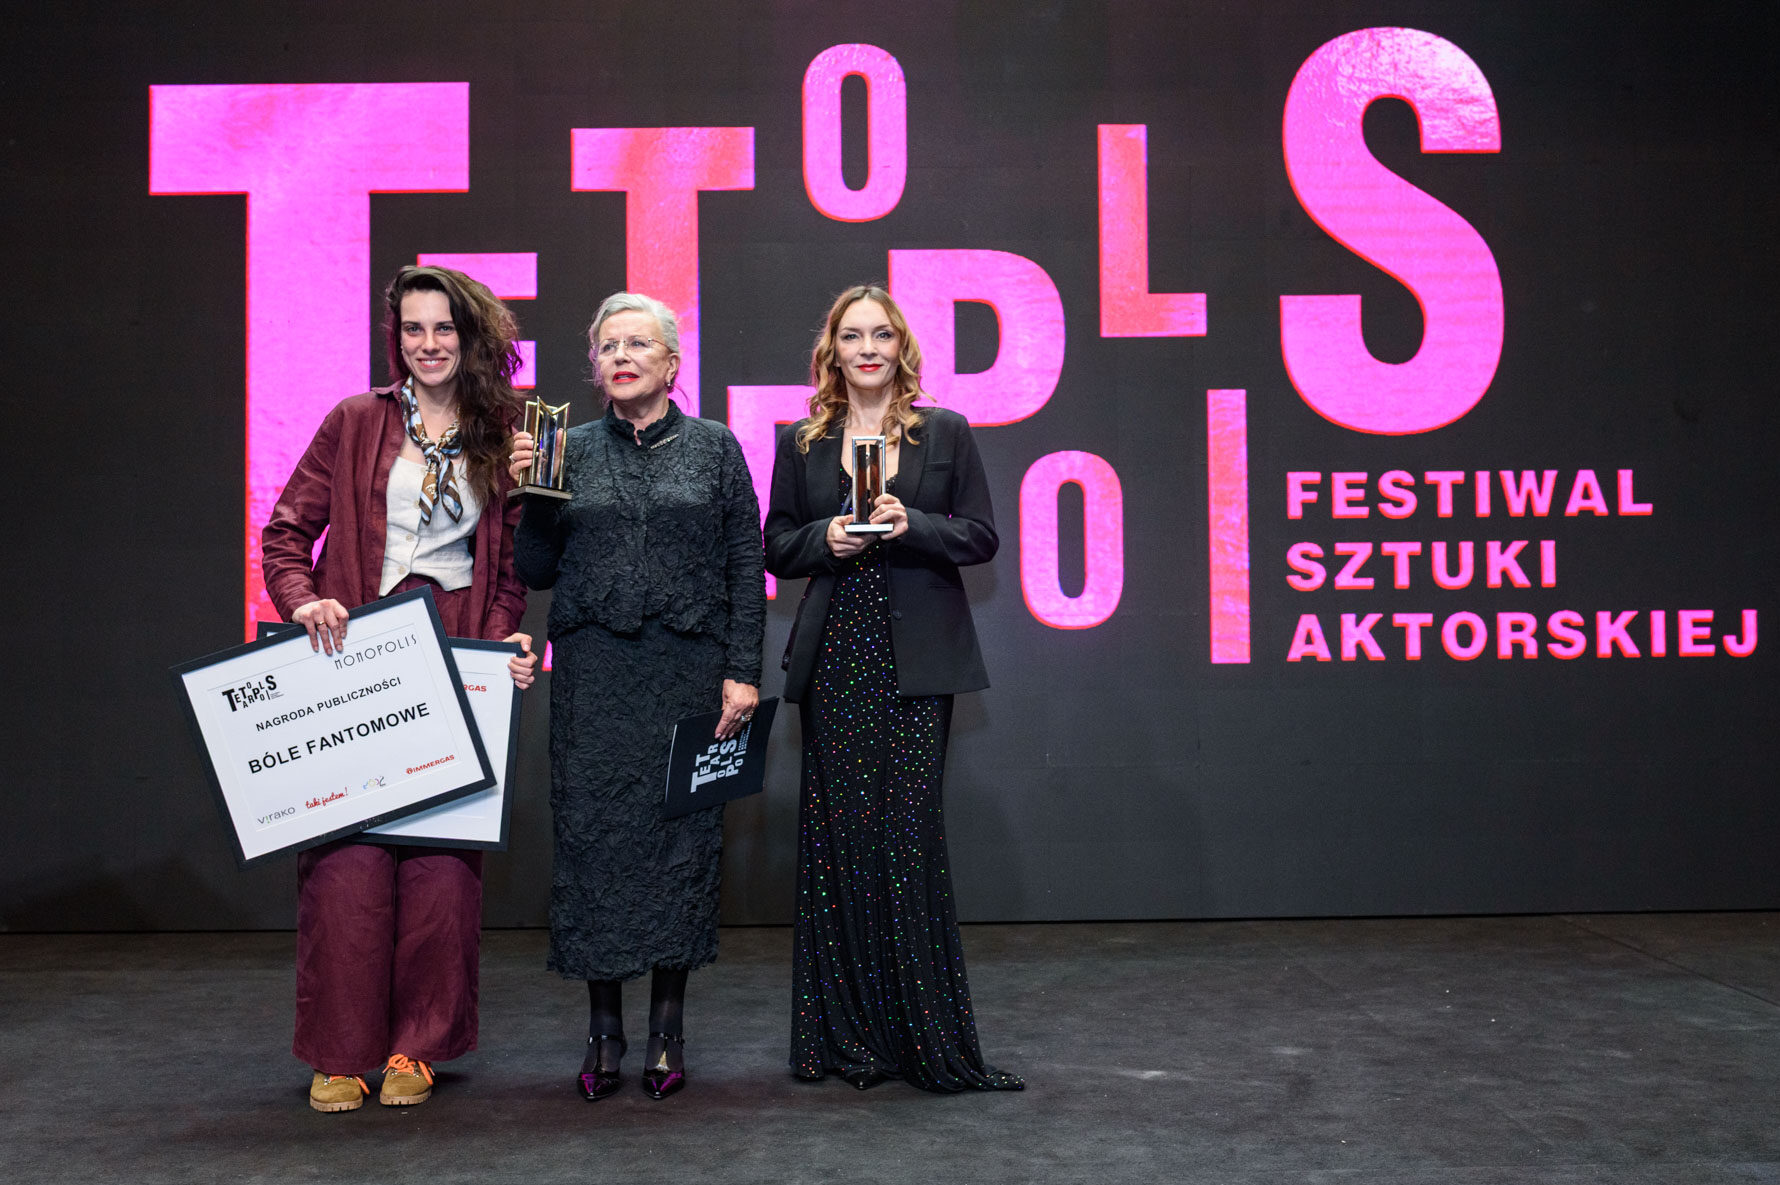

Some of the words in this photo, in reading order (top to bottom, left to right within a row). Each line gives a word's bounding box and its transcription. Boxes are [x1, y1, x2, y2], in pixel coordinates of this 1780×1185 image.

[1286, 468, 1654, 520] FESTIWAL
[1285, 539, 1557, 592] SZTUKI
[334, 633, 417, 670] MONOPOLIS
[1286, 608, 1758, 663] AKTORSKIEJ
[256, 707, 315, 732] NAGRODA
[316, 676, 402, 712] PUBLICZNOŚCI
[247, 745, 302, 774] BÓLE
[305, 702, 430, 755] FANTOMOWE
